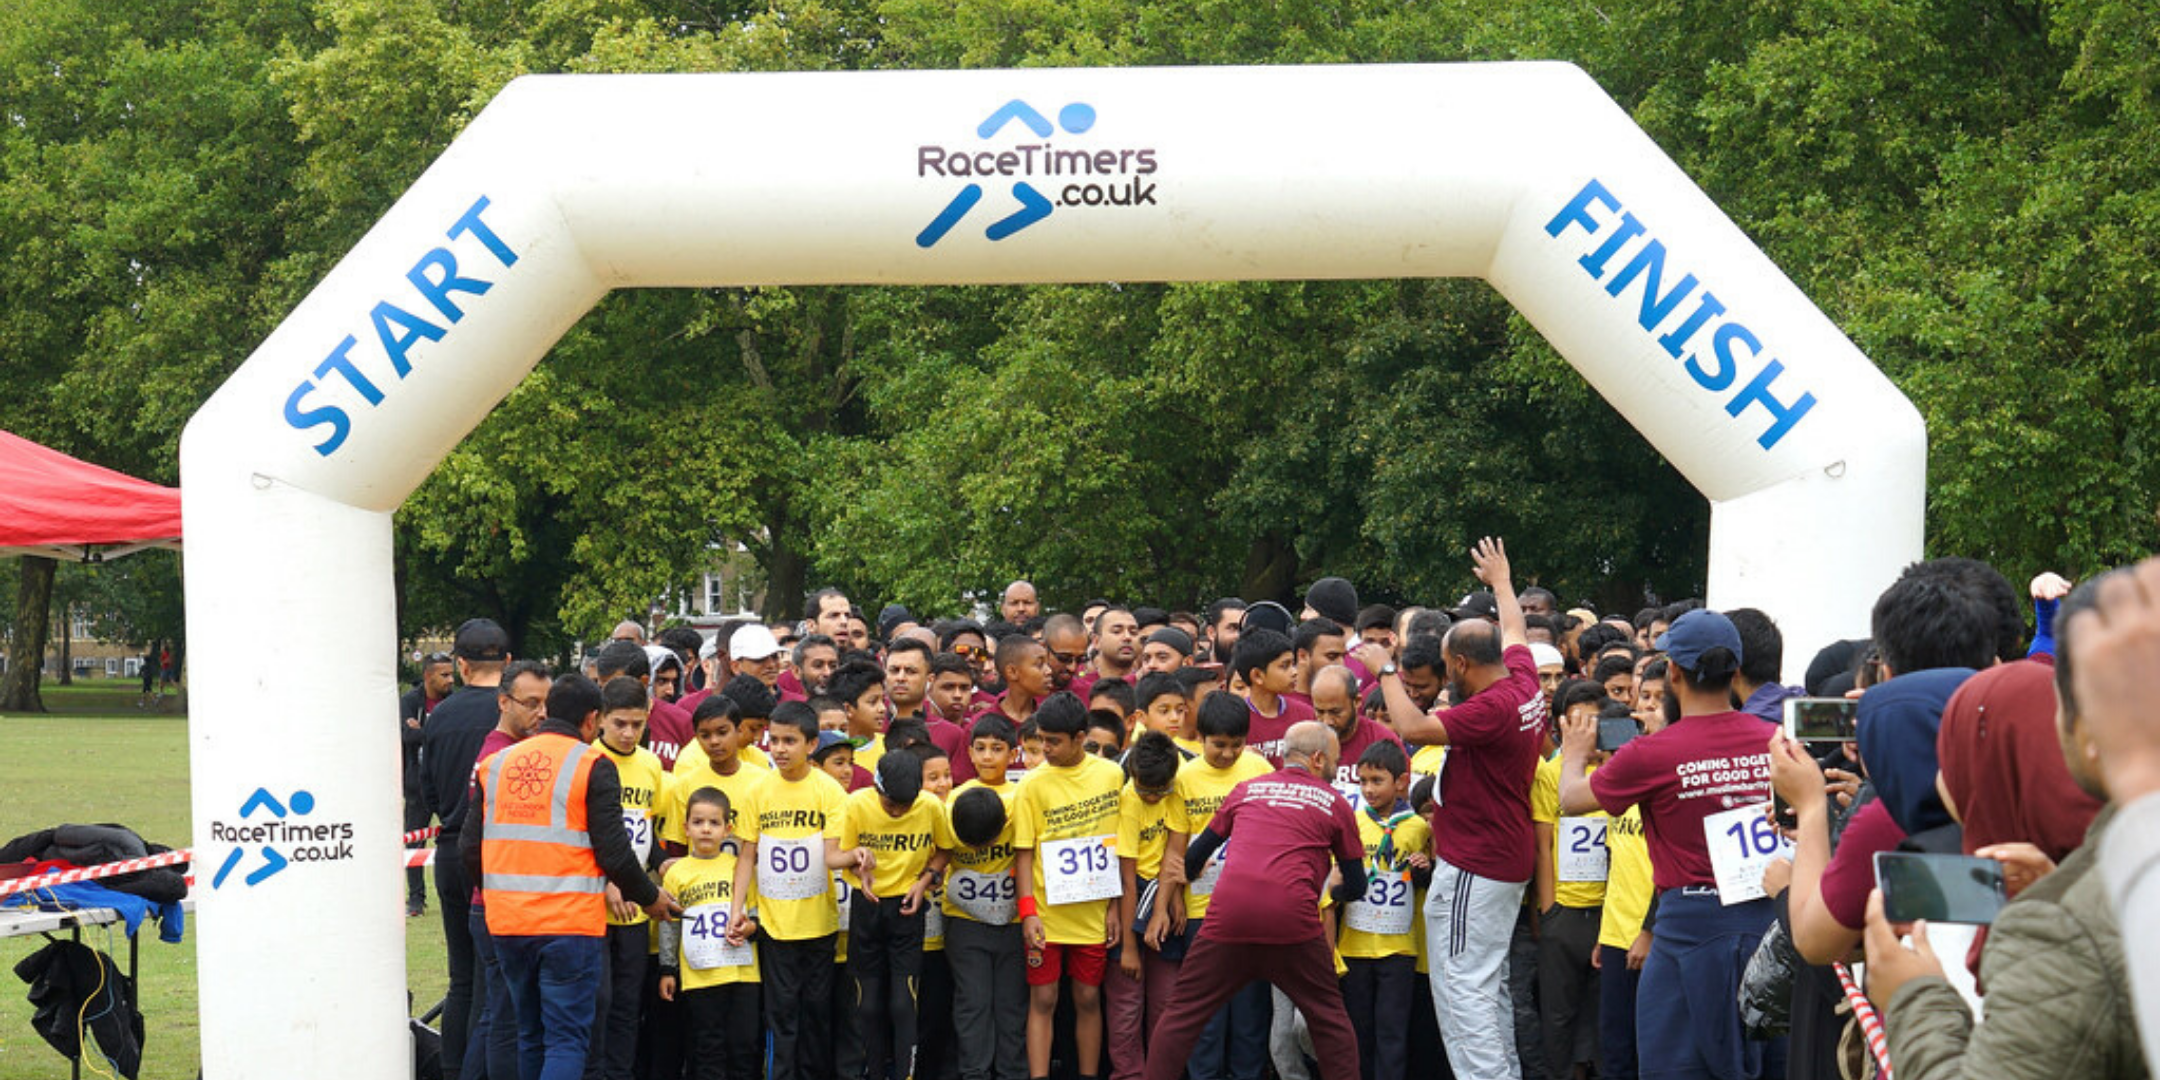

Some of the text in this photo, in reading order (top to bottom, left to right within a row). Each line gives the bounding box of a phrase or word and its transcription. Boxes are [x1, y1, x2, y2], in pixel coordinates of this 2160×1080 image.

[917, 143, 1158, 177] RaceTimers
[1055, 175, 1157, 206] .co.uk
[283, 194, 519, 457] START
[1544, 178, 1818, 451] FINISH
[1676, 753, 1772, 776] COMING TOGET
[1682, 773, 1710, 788] FOR
[1712, 769, 1750, 782] GOOD
[212, 821, 354, 843] RaceTimers
[1727, 815, 1790, 859] 16
[289, 840, 354, 862] .co.uk
[770, 846, 810, 873] 60
[1058, 844, 1108, 875] 313
[958, 875, 1016, 902] 349
